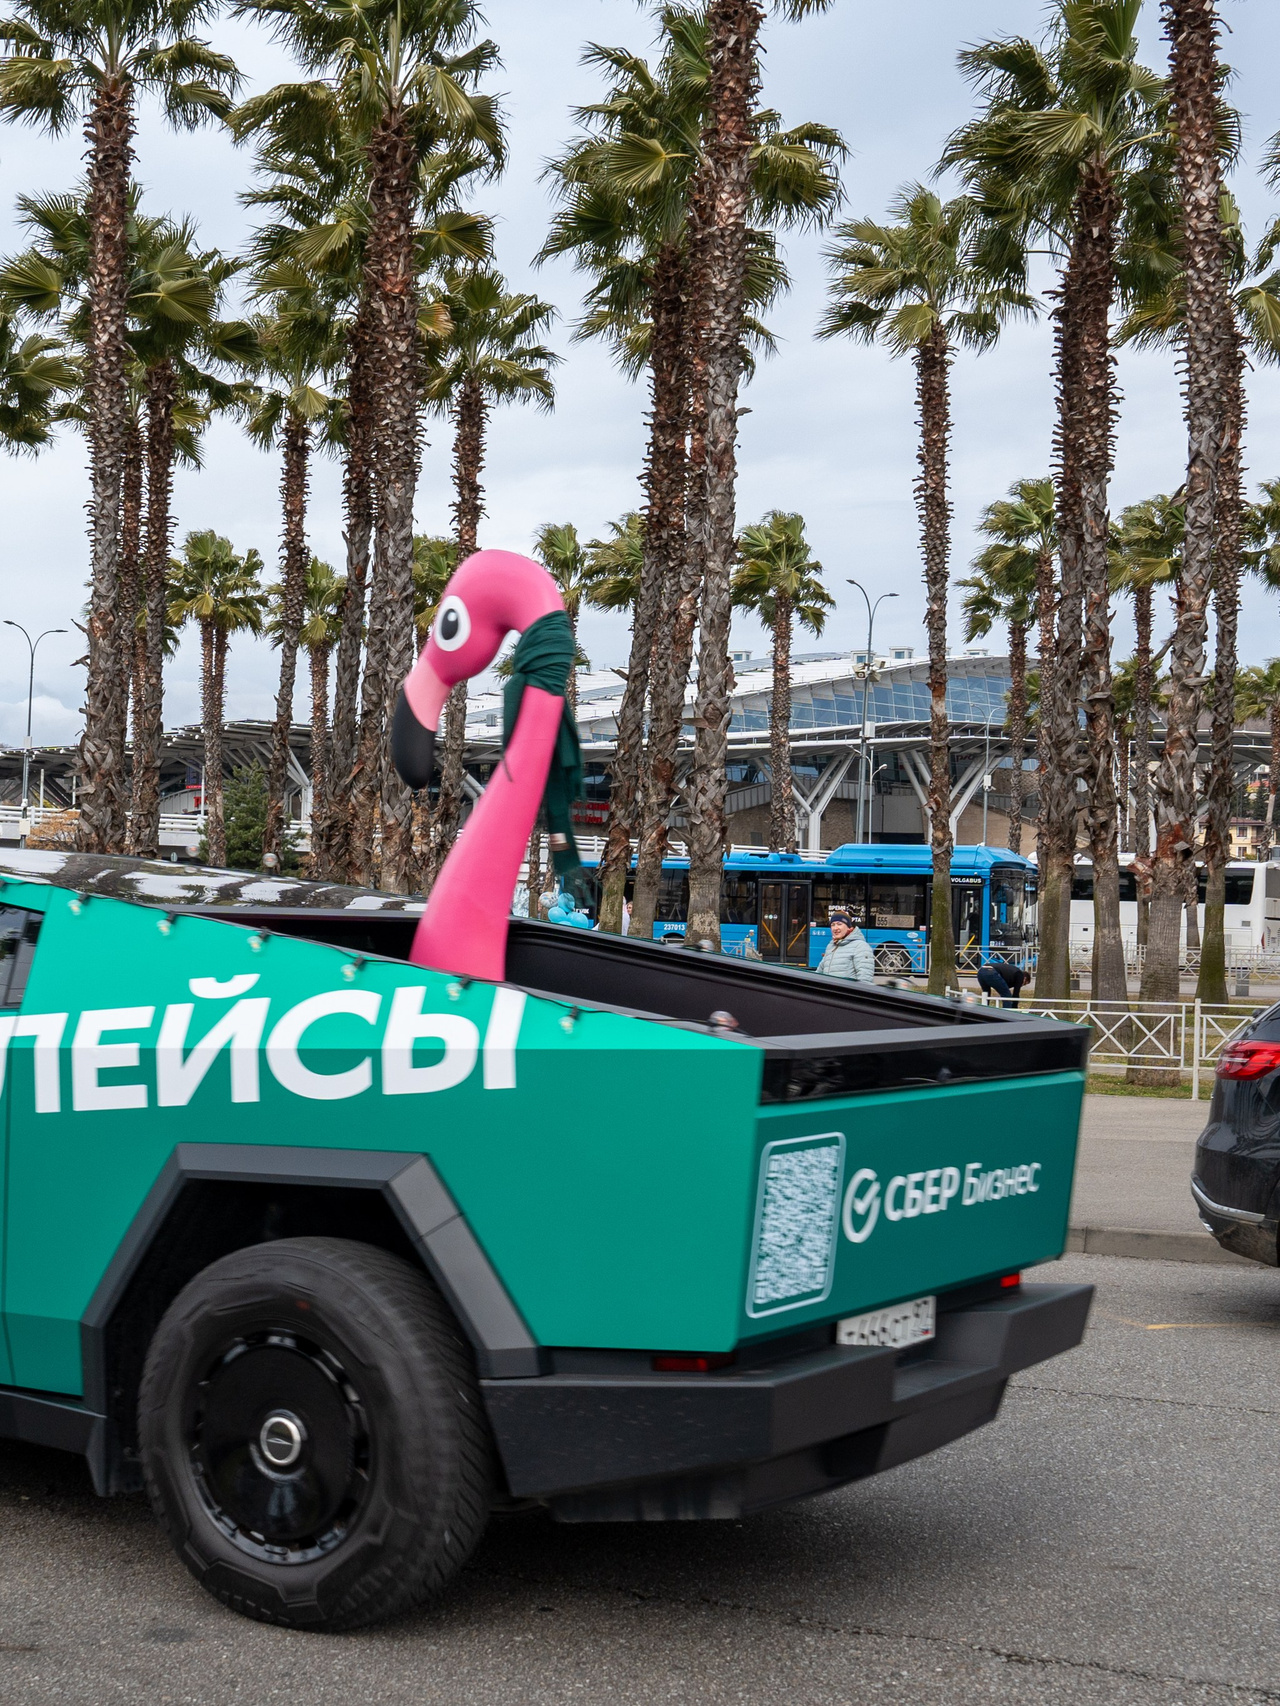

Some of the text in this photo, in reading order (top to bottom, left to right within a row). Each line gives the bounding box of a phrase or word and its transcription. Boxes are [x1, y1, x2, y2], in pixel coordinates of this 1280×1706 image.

[663, 923, 686, 931] 237013
[884, 1162, 1042, 1222] СБЕР Бизнес
